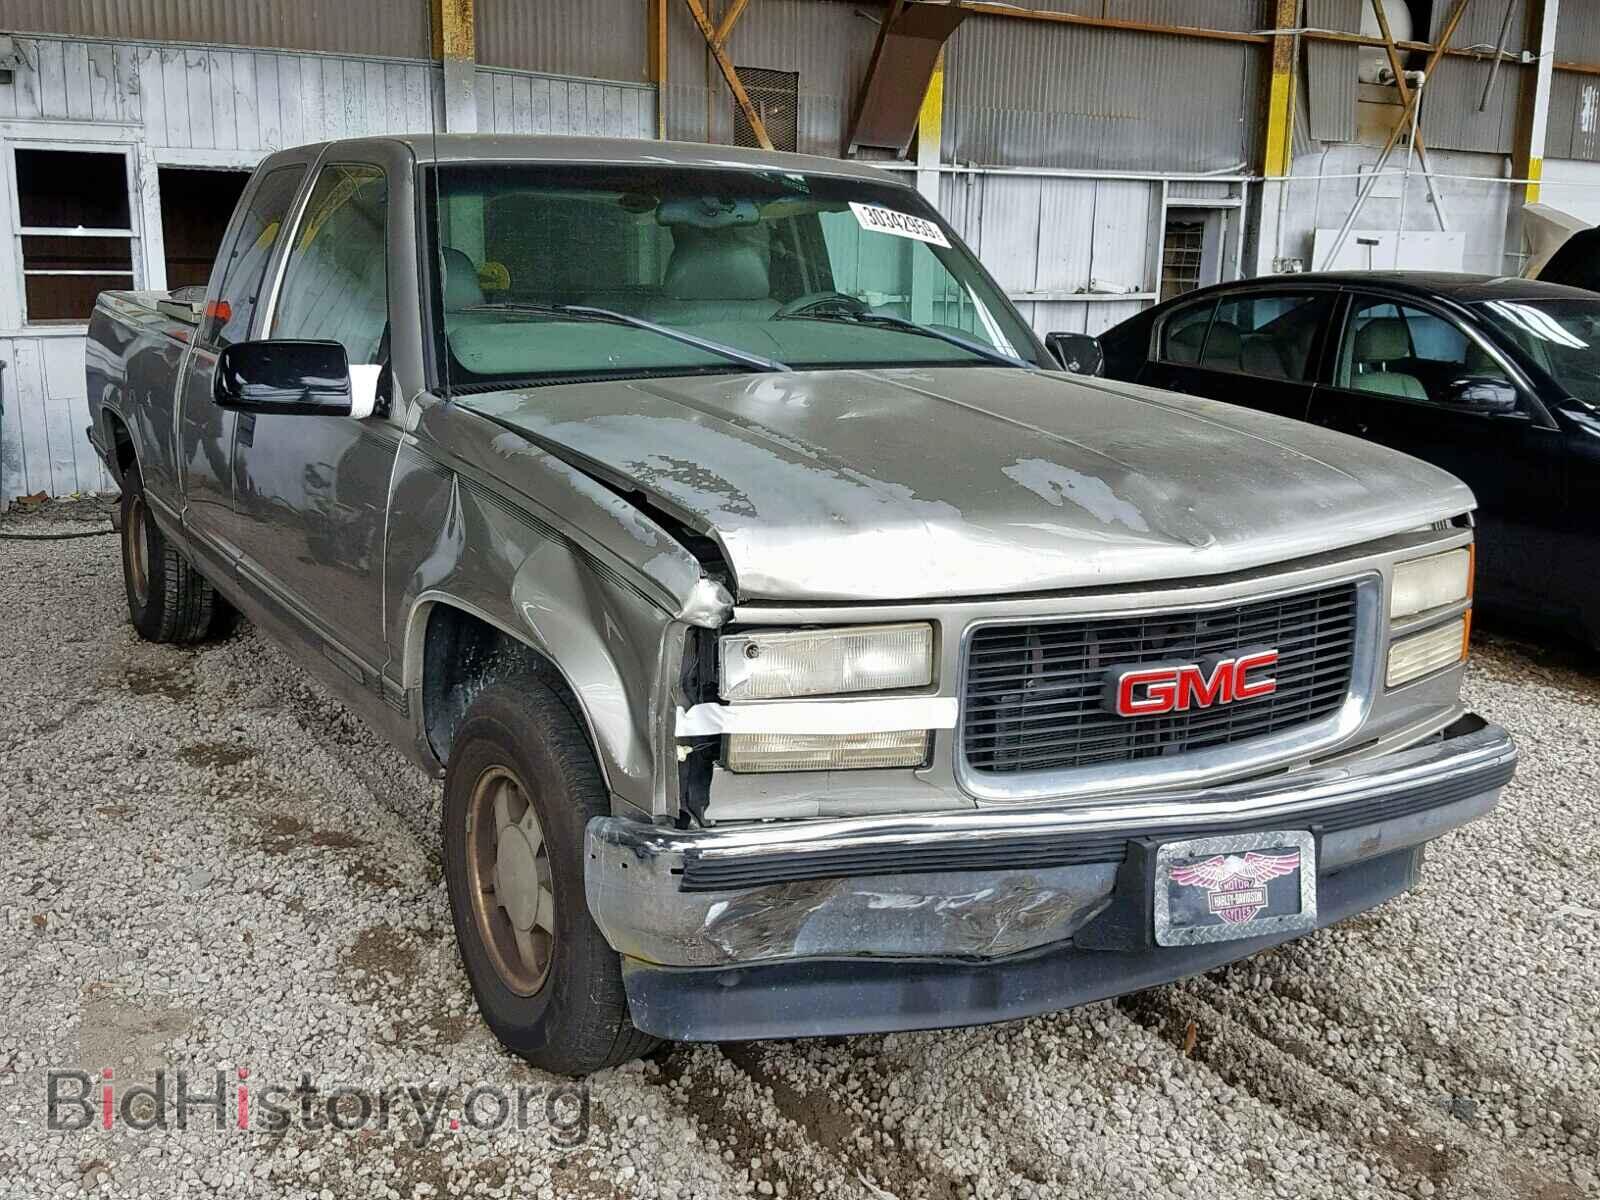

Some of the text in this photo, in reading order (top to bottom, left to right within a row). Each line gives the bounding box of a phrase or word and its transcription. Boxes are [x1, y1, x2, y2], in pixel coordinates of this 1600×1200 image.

[863, 206, 936, 239] 30342959
[1118, 649, 1278, 717] GMC
[1223, 880, 1250, 892] MOTOR
